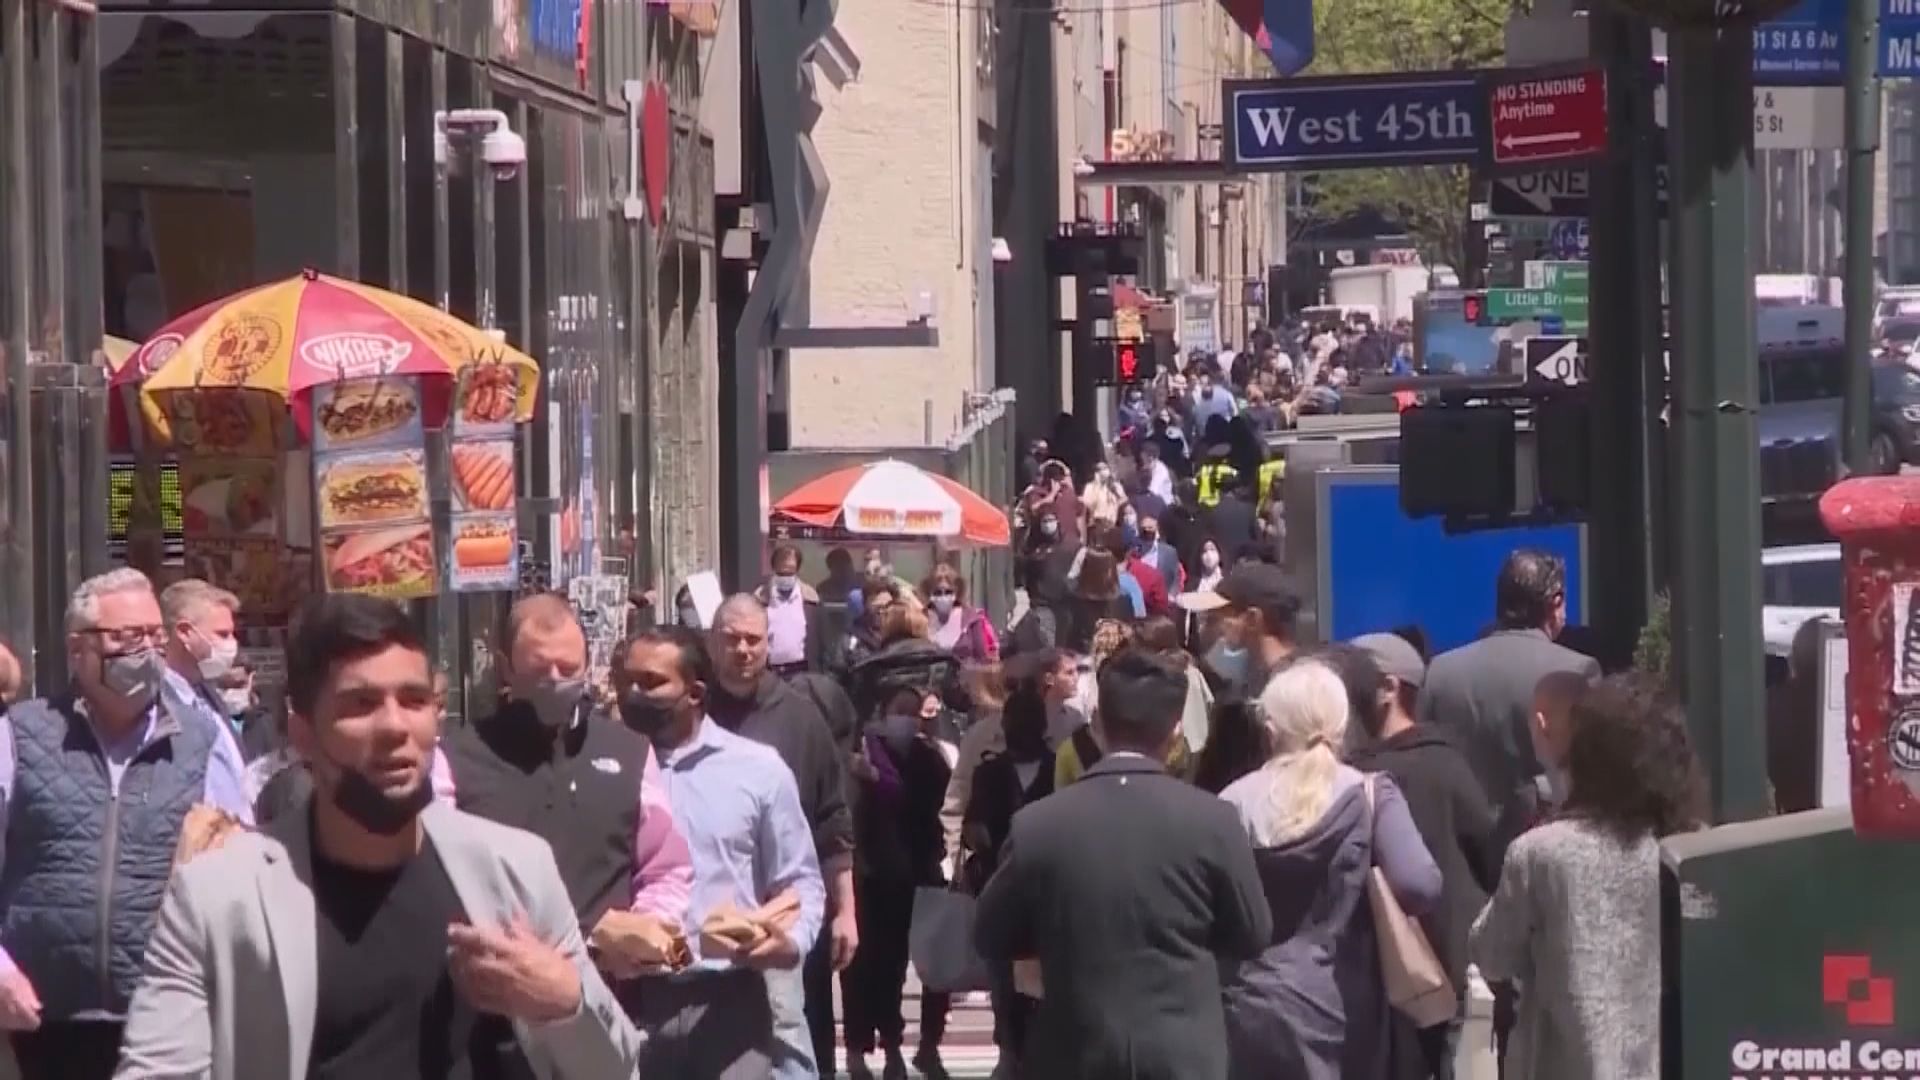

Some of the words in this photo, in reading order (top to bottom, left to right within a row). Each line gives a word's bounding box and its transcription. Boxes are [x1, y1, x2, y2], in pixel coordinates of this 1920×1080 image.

[1772, 30, 1787, 49] St
[1791, 31, 1802, 49] &
[1806, 30, 1816, 49] 6
[1820, 30, 1838, 49] Av
[1497, 84, 1517, 101] NO
[1519, 77, 1586, 99] STANDING
[1499, 101, 1555, 122] Anytime
[1764, 92, 1774, 109] &
[1246, 105, 1363, 148] West
[1375, 100, 1474, 142] 45th
[1769, 115, 1783, 133] St
[1516, 168, 1586, 194] ONE
[1504, 291, 1540, 306] Little
[313, 338, 384, 368] NIKAS
[1732, 1040, 1851, 1071] Grand
